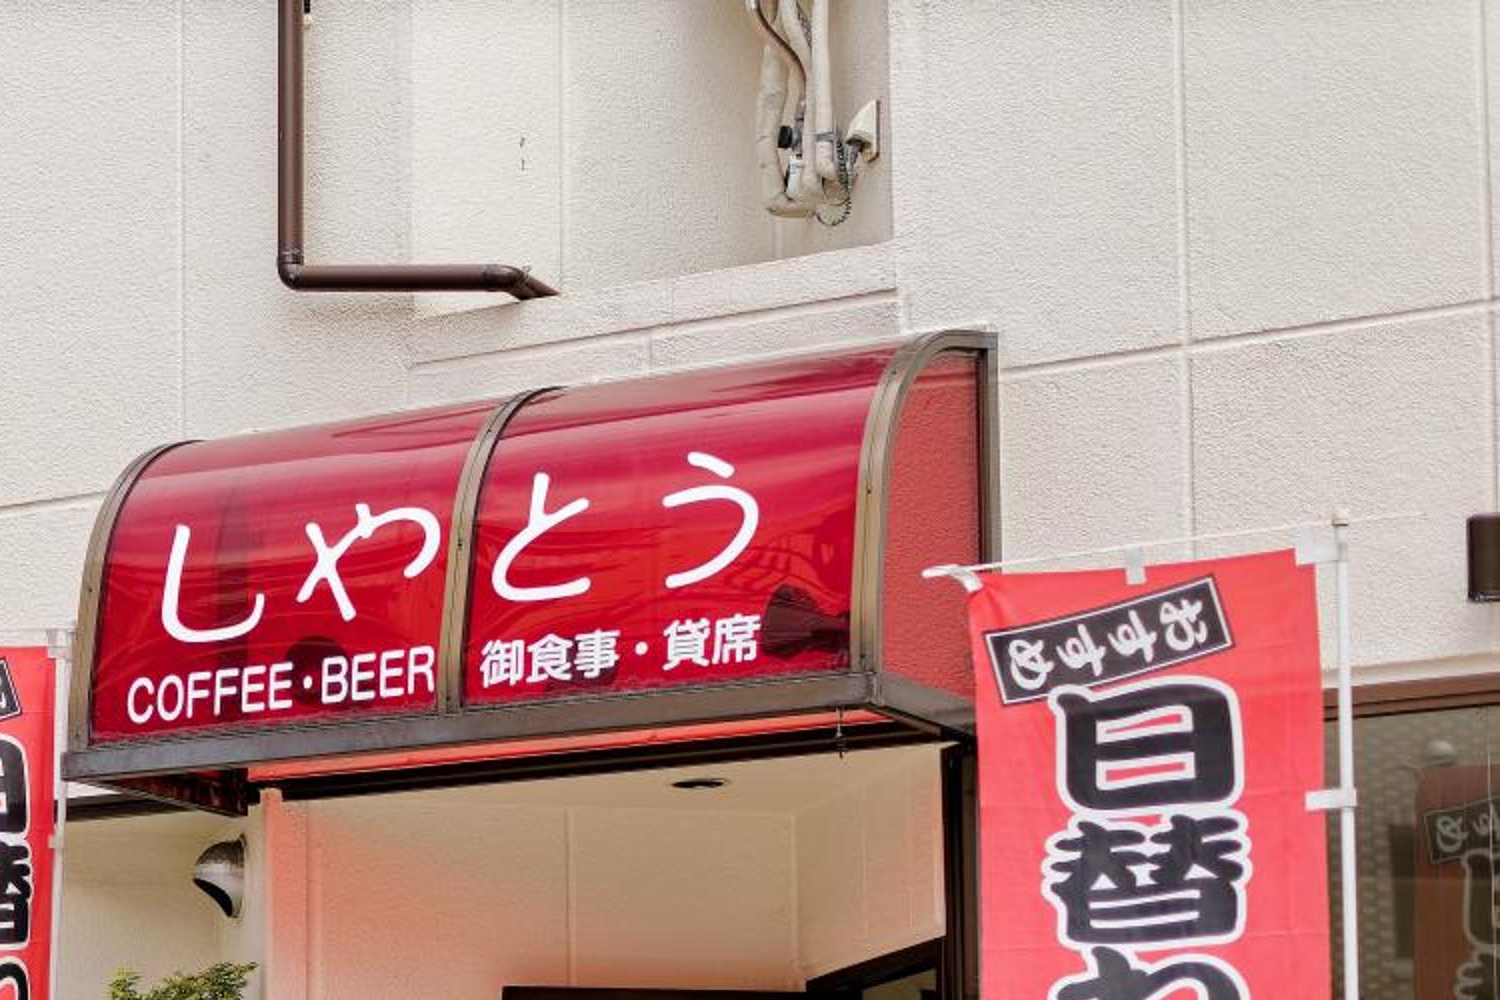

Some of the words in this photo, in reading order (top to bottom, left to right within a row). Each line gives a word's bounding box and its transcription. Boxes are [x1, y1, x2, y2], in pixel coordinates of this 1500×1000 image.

[479, 613, 762, 689] 御食事・貸席
[1008, 597, 1208, 690] おすすめ
